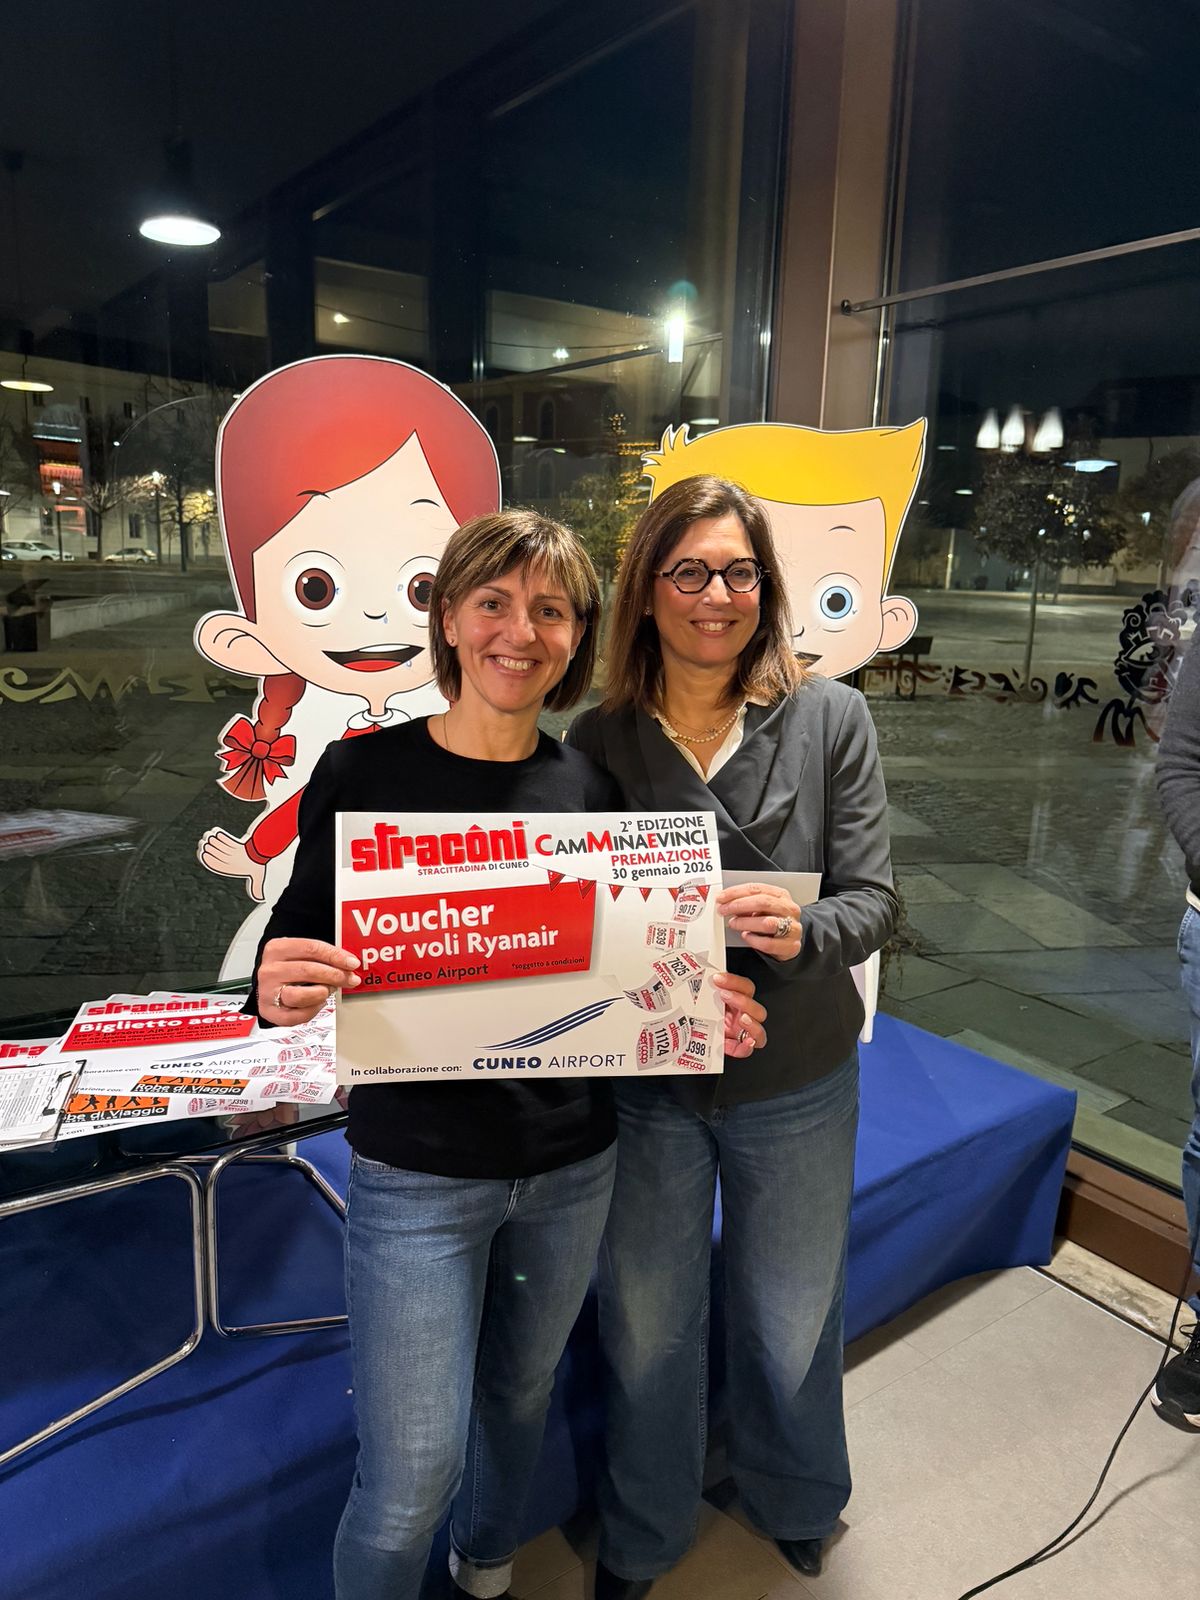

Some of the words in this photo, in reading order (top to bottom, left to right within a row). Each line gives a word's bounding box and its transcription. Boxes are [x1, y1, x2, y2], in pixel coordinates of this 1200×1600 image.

[620, 820, 633, 832] 2°
[637, 816, 705, 832] EDIZIONE
[351, 821, 528, 872] stracôni
[611, 848, 712, 867] PREMIAZIONE
[418, 864, 487, 876] STRACITTADINA
[488, 863, 498, 871] DI
[499, 861, 530, 871] CUNEO
[612, 867, 627, 879] 30
[632, 865, 681, 882] gennaio
[684, 861, 714, 874] 2026
[352, 898, 495, 937] Voucher
[362, 945, 406, 970] per
[413, 932, 460, 959] voli
[467, 925, 559, 958] Ryanair
[364, 973, 382, 985] da
[387, 970, 433, 984] Cuneo
[437, 964, 489, 980] Airport
[668, 956, 690, 976] 7625
[79, 1020, 183, 1034] Biglietto
[188, 1014, 254, 1026] aereo
[150, 1062, 203, 1070] CUNEO
[208, 1057, 270, 1067] AIRPORT
[351, 1068, 360, 1076] In
[364, 1065, 439, 1076] collaborazione
[441, 1064, 463, 1072] con:
[472, 1057, 542, 1070] CUNEO
[548, 1054, 626, 1068] AIRPORT
[135, 1084, 170, 1092] Robe
[192, 1084, 242, 1094] Viaggio
